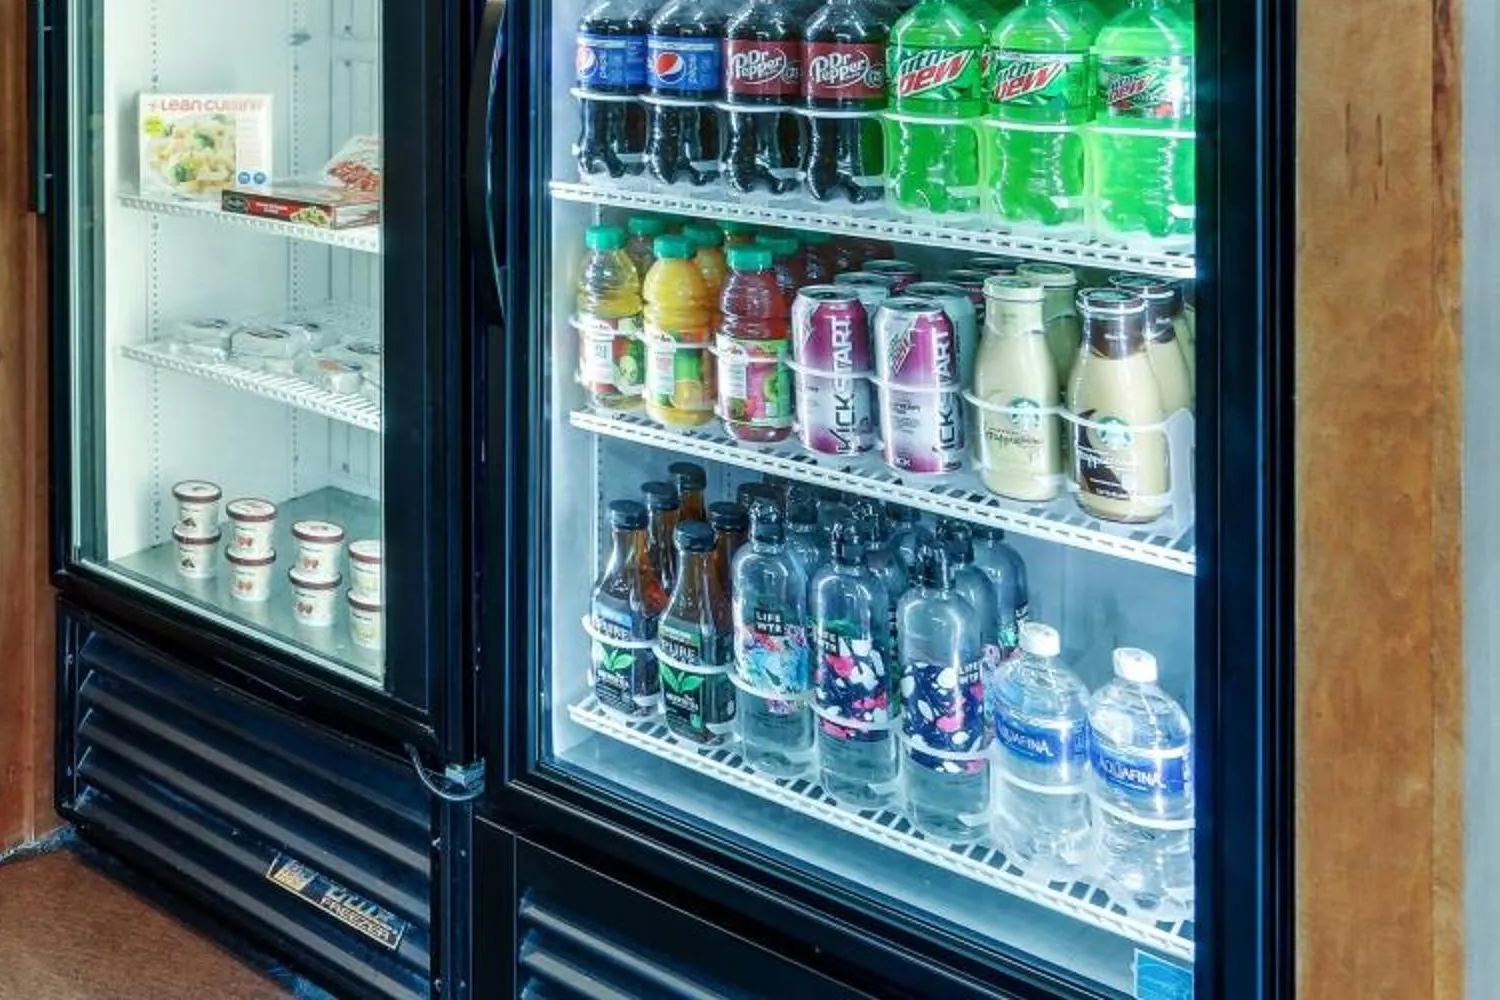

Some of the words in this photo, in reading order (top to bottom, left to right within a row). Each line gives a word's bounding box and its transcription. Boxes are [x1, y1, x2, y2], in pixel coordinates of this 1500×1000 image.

[750, 50, 769, 66] Dr
[830, 52, 850, 69] Dr
[734, 55, 783, 83] Pepper
[811, 60, 867, 83] Pepper
[755, 611, 782, 623] LIFE
